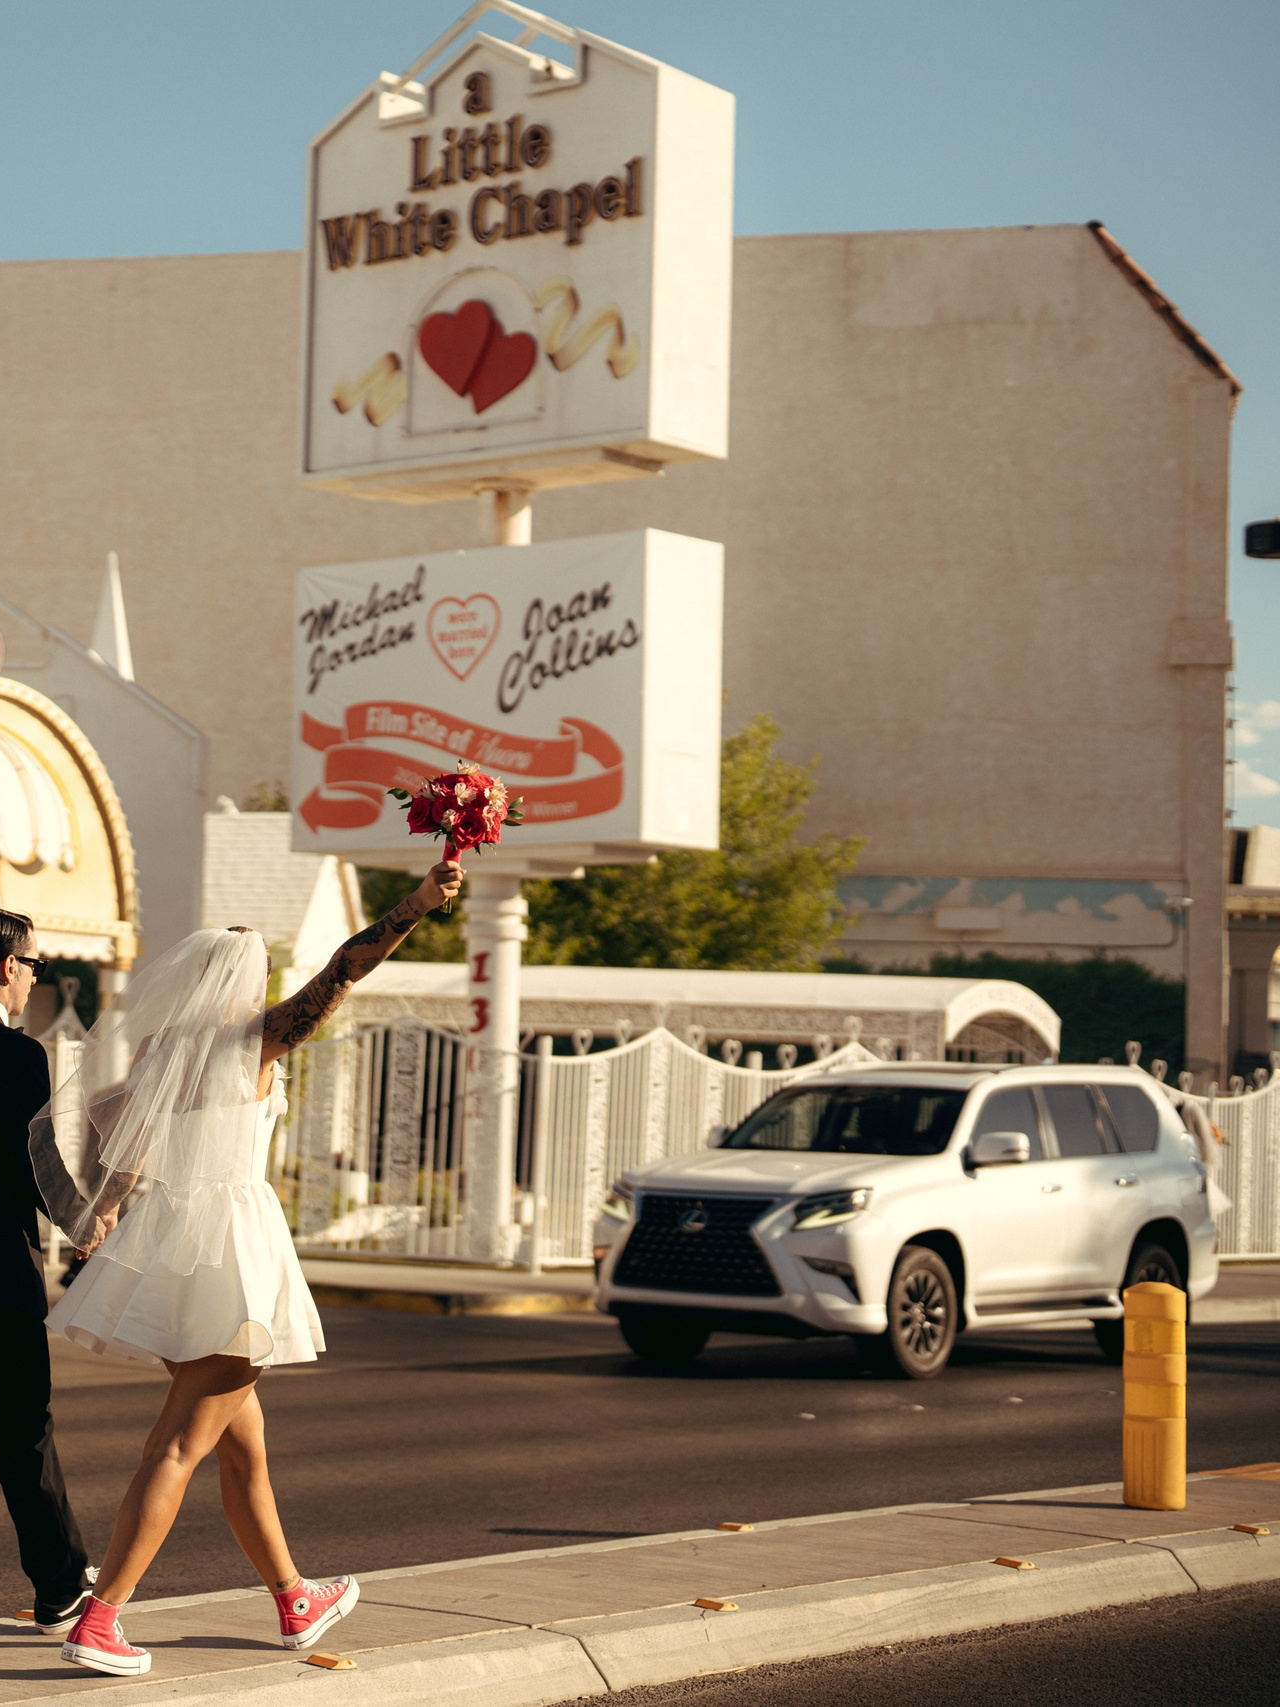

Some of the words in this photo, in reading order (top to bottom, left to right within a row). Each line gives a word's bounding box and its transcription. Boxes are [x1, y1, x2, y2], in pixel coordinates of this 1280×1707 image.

[463, 72, 493, 115] a
[408, 113, 552, 192] Little
[321, 200, 457, 271] White
[470, 156, 644, 246] Chapel
[301, 564, 426, 643] Michael
[523, 582, 612, 664] Joan
[307, 621, 416, 695] Jordan
[497, 618, 639, 714] Collins
[365, 706, 409, 734] Film
[409, 711, 450, 745] Site
[447, 728, 476, 756] of
